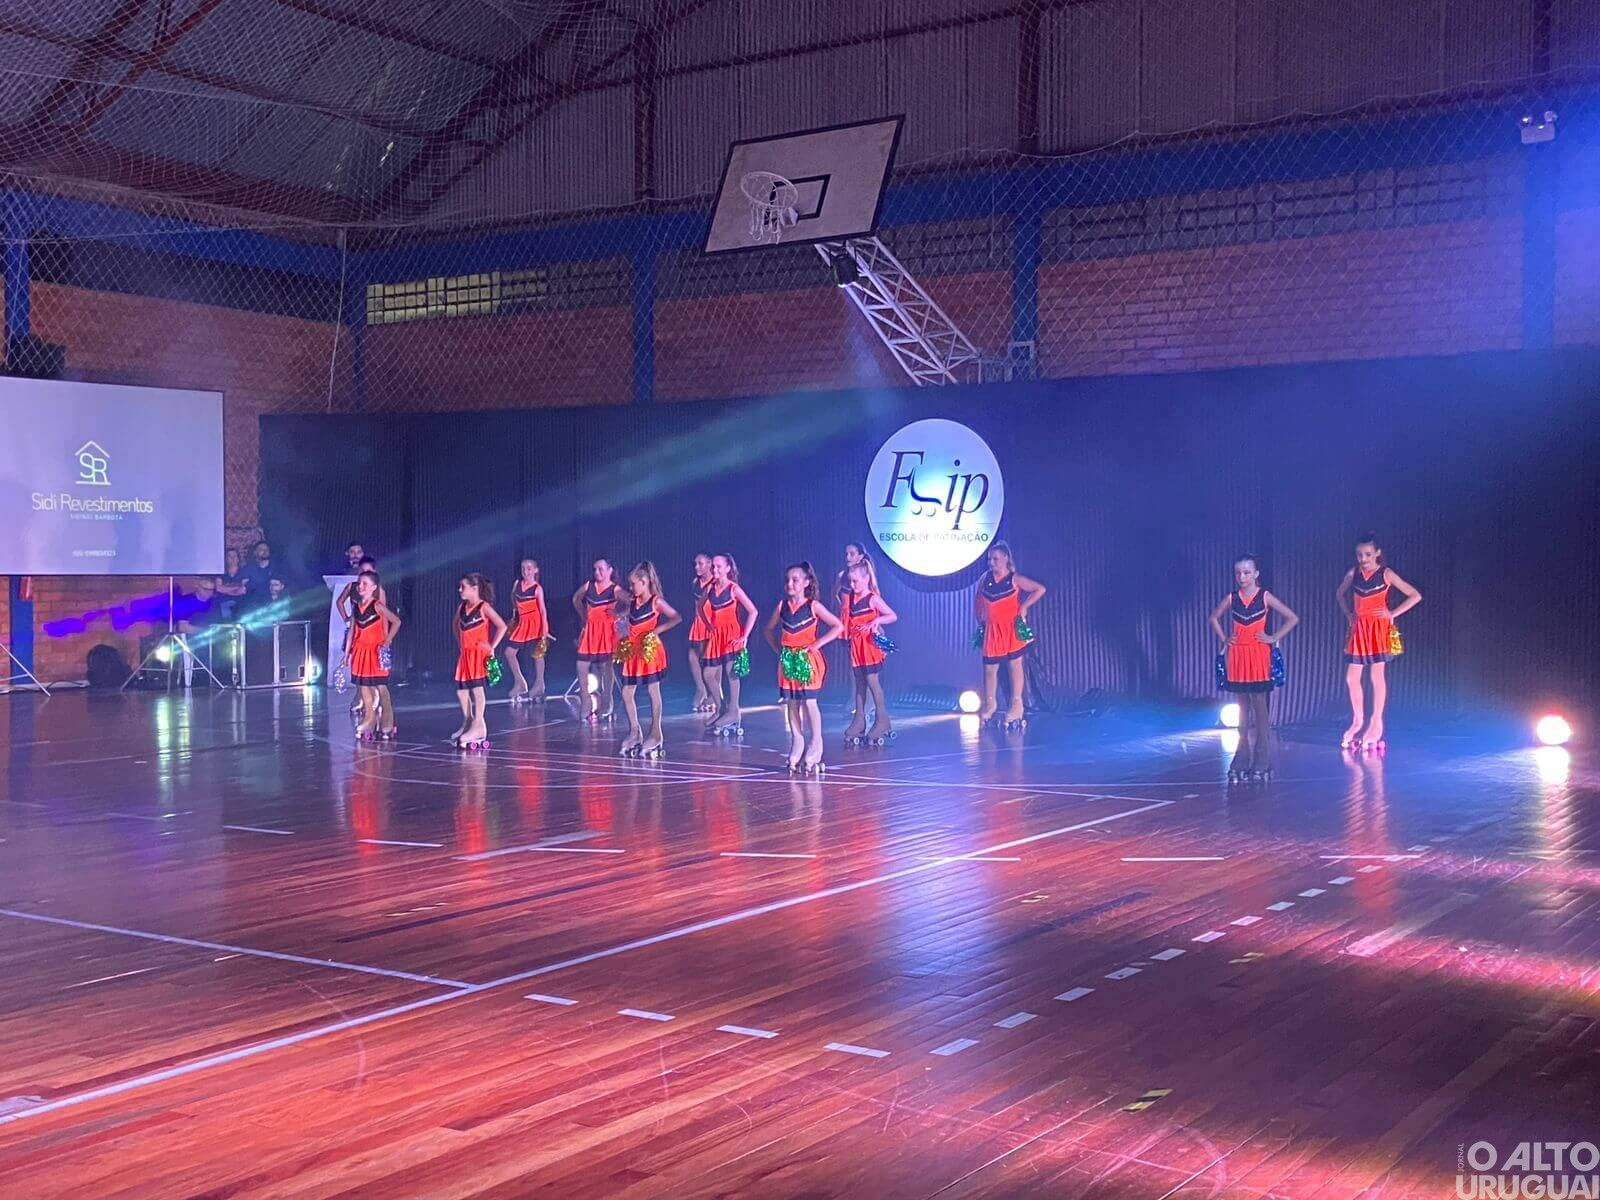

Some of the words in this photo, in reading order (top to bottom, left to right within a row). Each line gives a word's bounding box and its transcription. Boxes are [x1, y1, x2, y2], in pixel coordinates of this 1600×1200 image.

[31, 491, 57, 511] Sidi
[60, 494, 154, 514] Revestimentos
[880, 532, 917, 542] ESCOLA
[919, 533, 929, 542] DE
